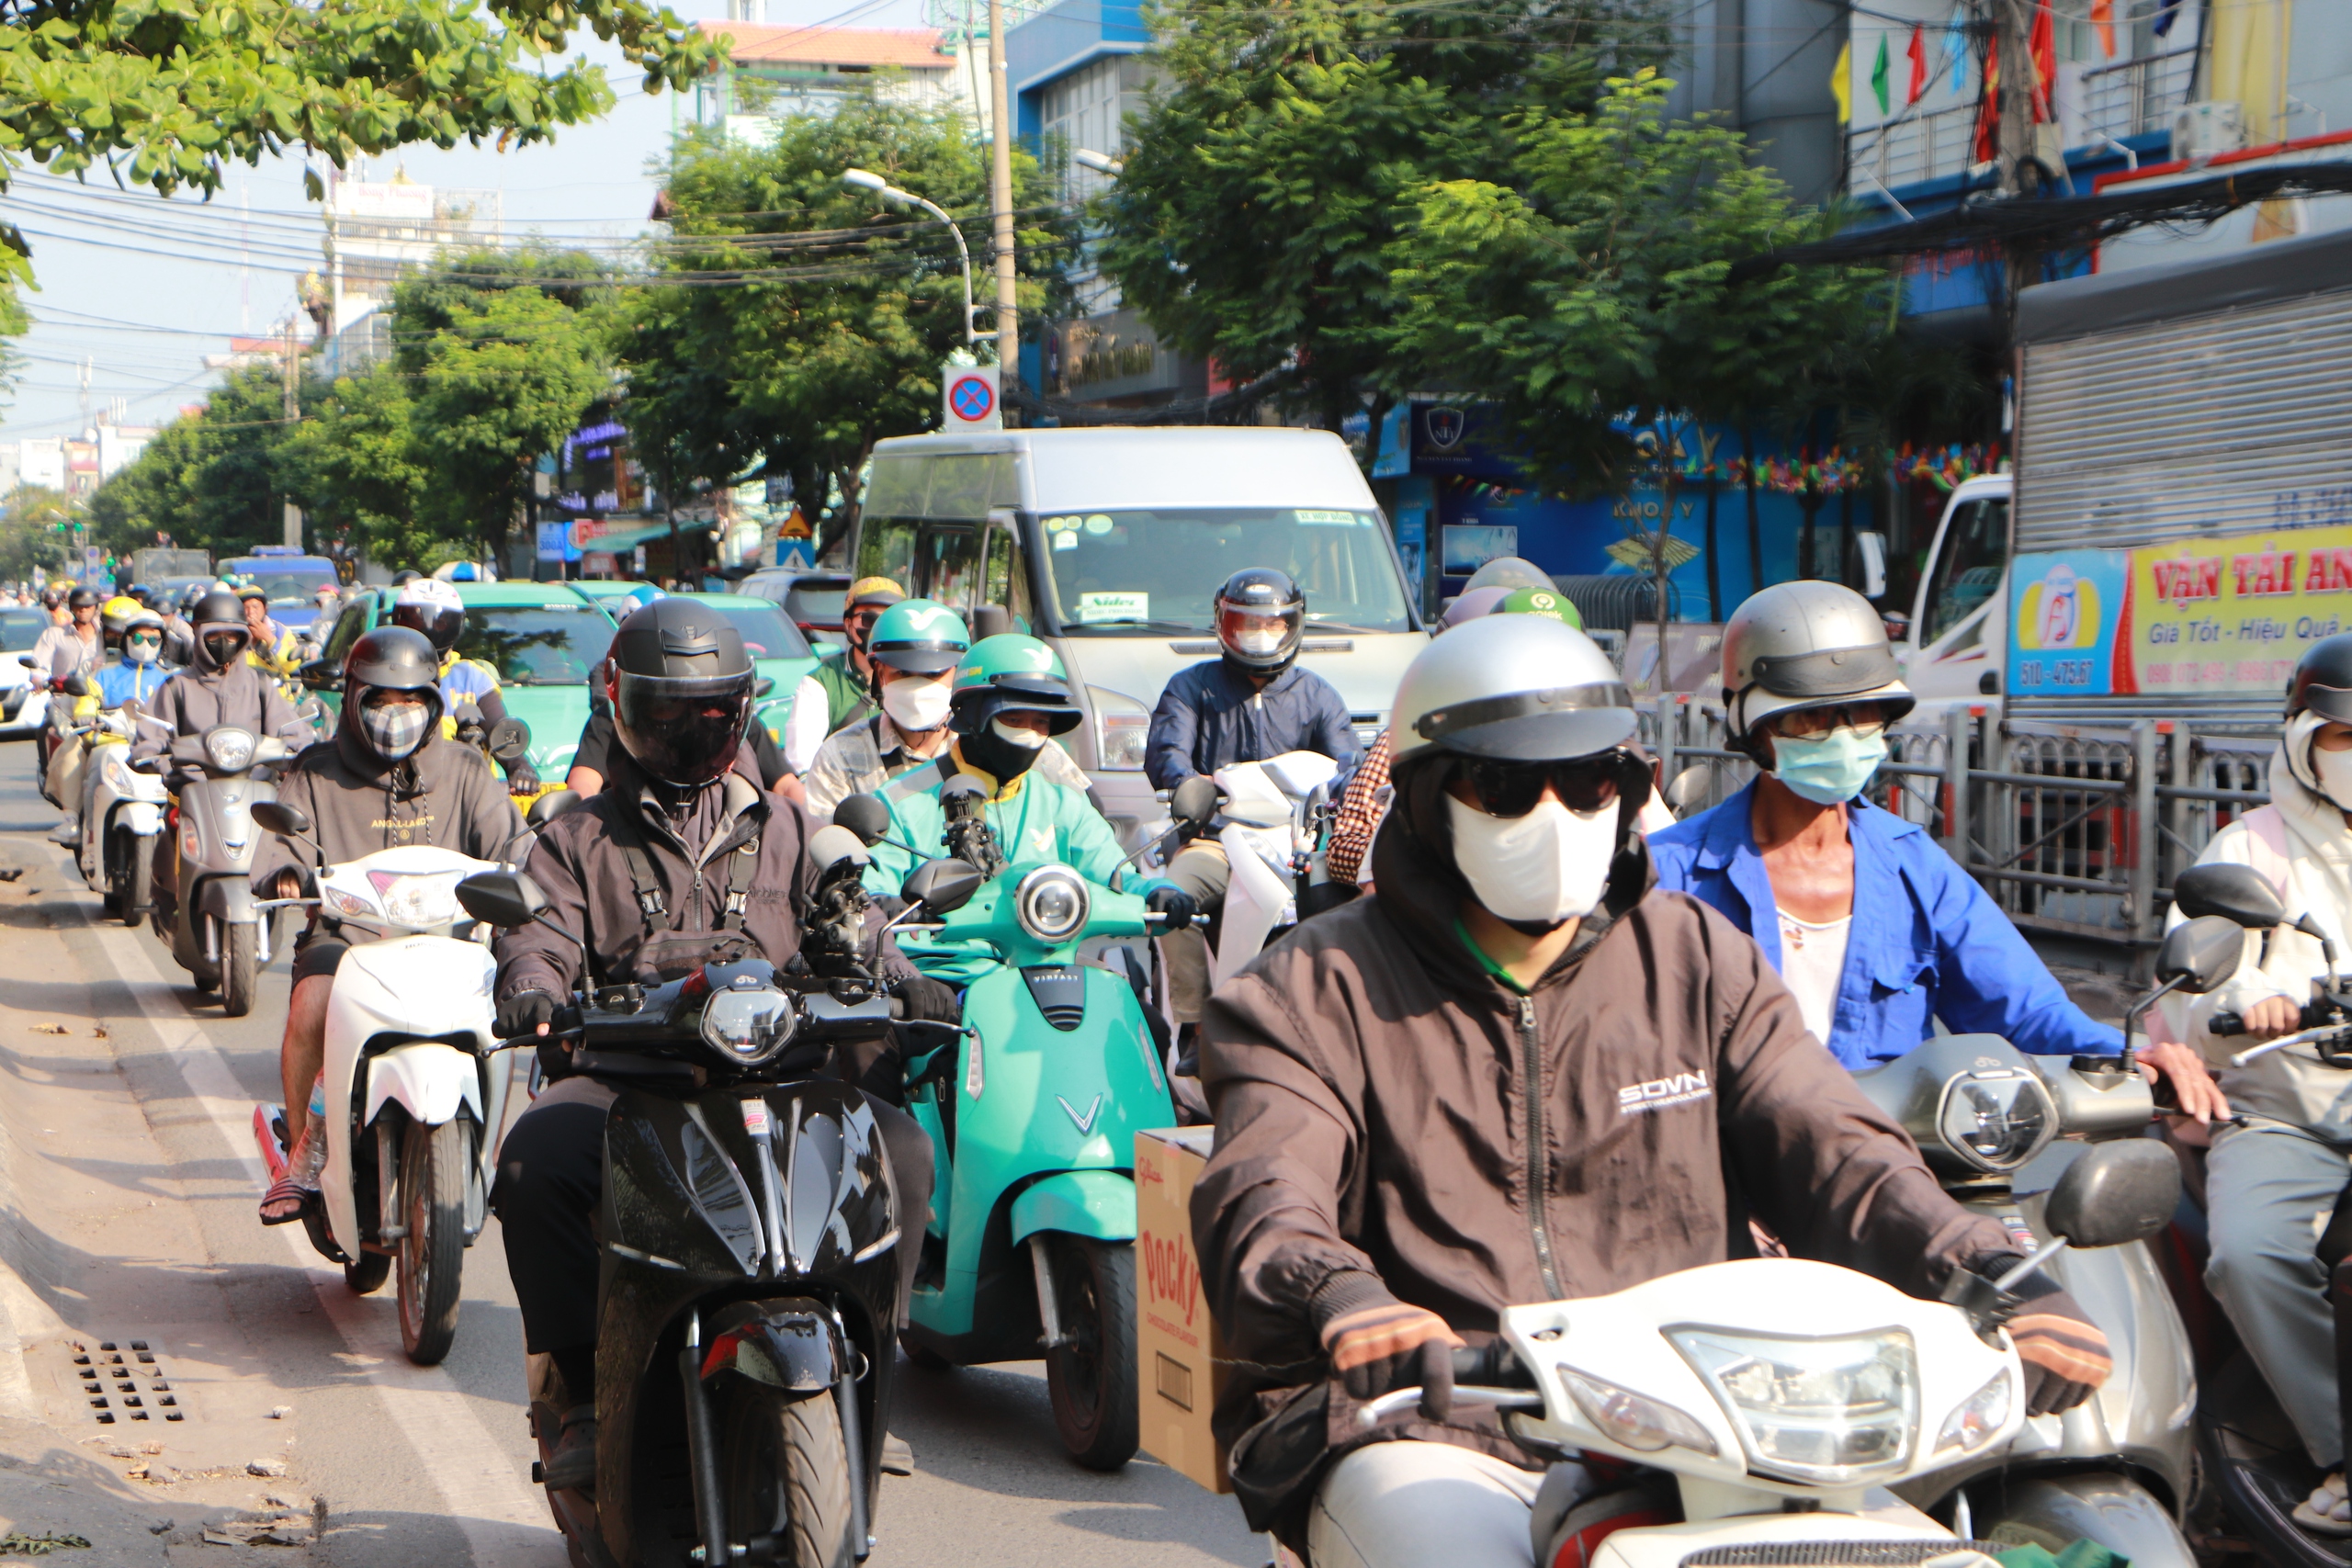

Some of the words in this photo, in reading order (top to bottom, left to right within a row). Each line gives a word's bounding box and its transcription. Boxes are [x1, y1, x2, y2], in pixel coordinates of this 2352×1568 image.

[1680, 502, 1695, 517] Y
[2232, 540, 2296, 597] TẢI
[1092, 596, 1136, 606] Nidec
[2149, 621, 2179, 643] Giá
[2188, 615, 2221, 642] Tốt
[2237, 617, 2288, 643] Hiệu
[2294, 614, 2339, 638] Quả
[2021, 660, 2042, 685] 51D
[2052, 658, 2095, 685] 475.67
[1034, 974, 1079, 983] VINFAST
[1619, 1068, 1709, 1104] SDVN
